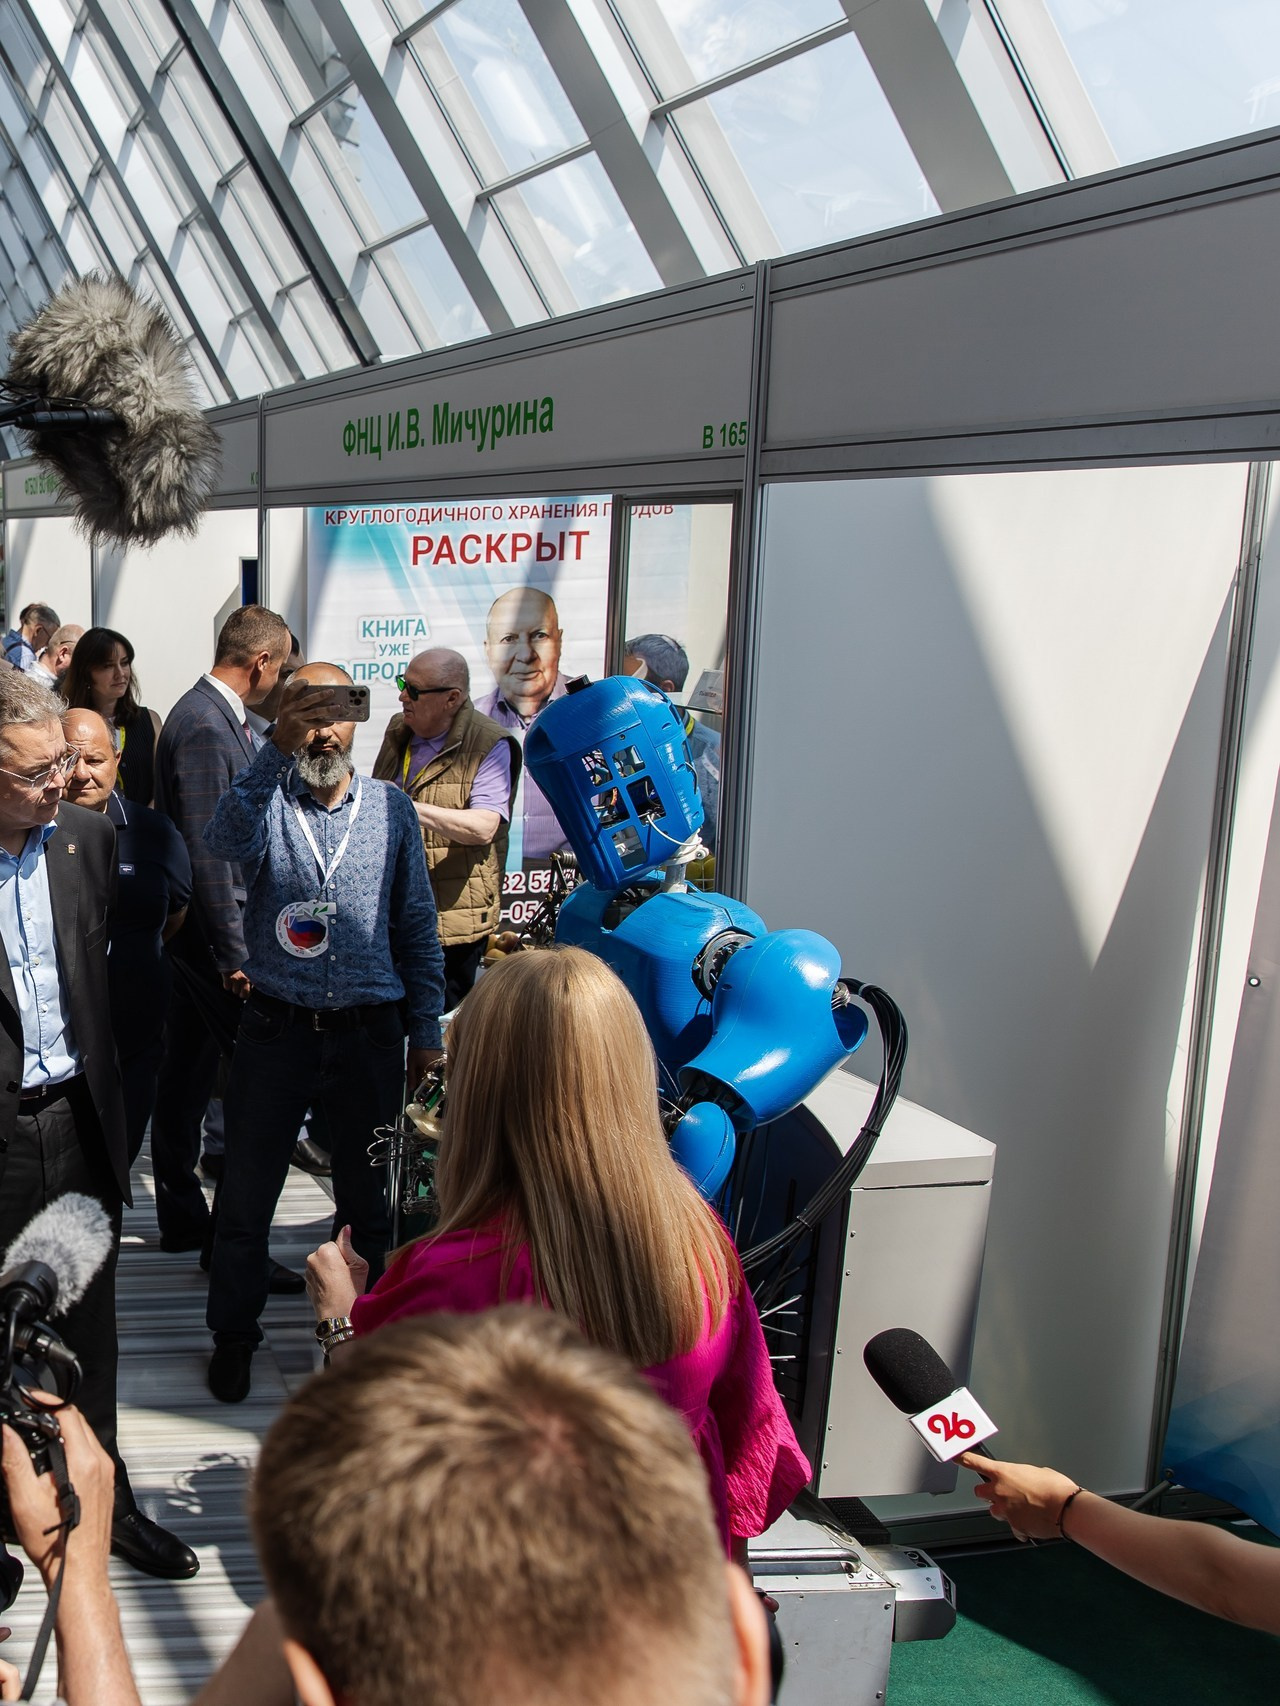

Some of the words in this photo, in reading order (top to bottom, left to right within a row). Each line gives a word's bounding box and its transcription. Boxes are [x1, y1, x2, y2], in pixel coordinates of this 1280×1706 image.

[343, 414, 381, 460] ФНЦ
[387, 408, 424, 451] И.В.
[432, 396, 554, 452] Мичурина
[720, 421, 747, 447] 165
[325, 506, 503, 525] КРУГЛОГОДИЧНОГО
[508, 503, 598, 519] ХРАНЕНИЯ
[412, 530, 590, 566] РАСКРЫТ
[362, 618, 427, 638] КНИГА
[378, 643, 410, 656] УЖЕ
[927, 1412, 976, 1442] 26
